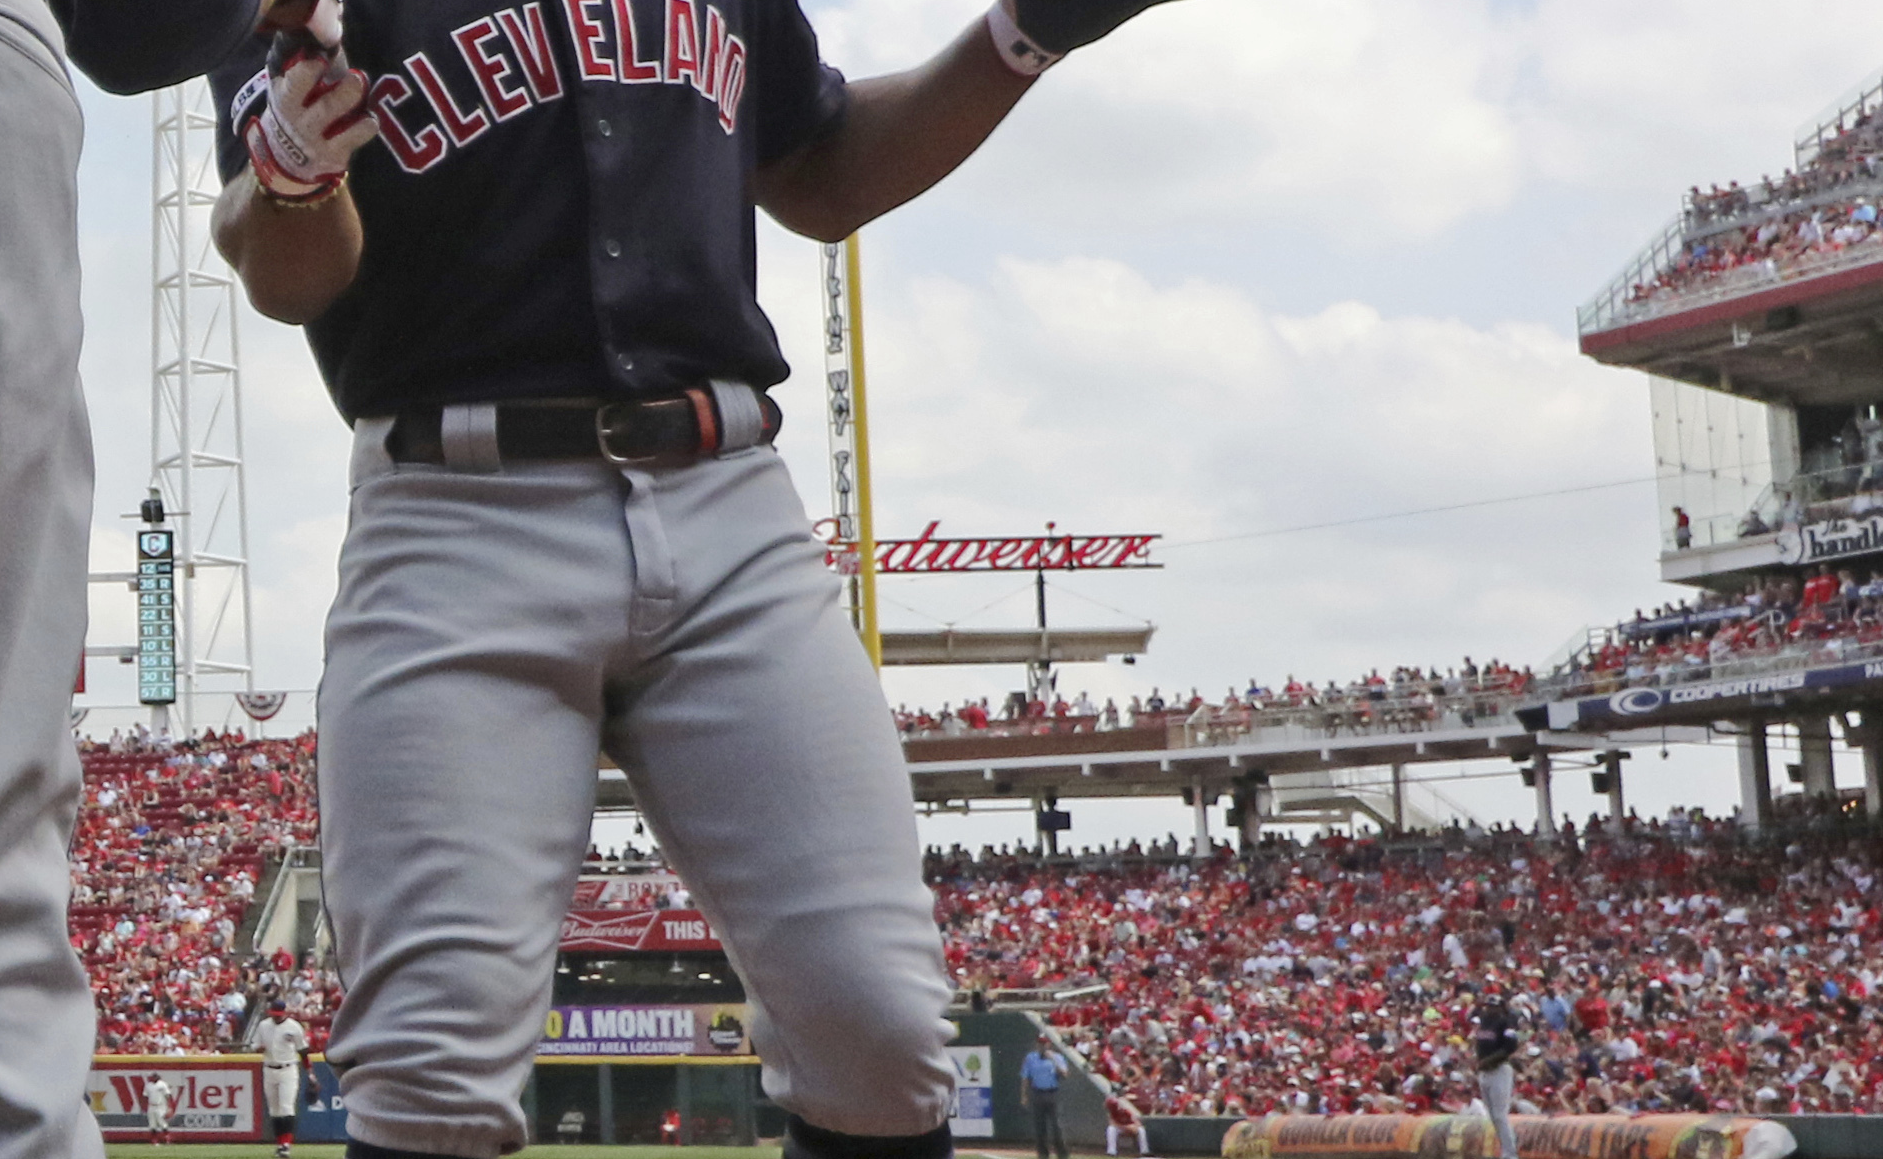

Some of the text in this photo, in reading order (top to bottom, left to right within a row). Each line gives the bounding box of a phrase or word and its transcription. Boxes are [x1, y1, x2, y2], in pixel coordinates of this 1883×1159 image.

[140, 594, 154, 605] 41
[142, 641, 156, 651] 10
[662, 921, 705, 940] THIS
[568, 1010, 588, 1038] A
[591, 1009, 694, 1038] MONTH
